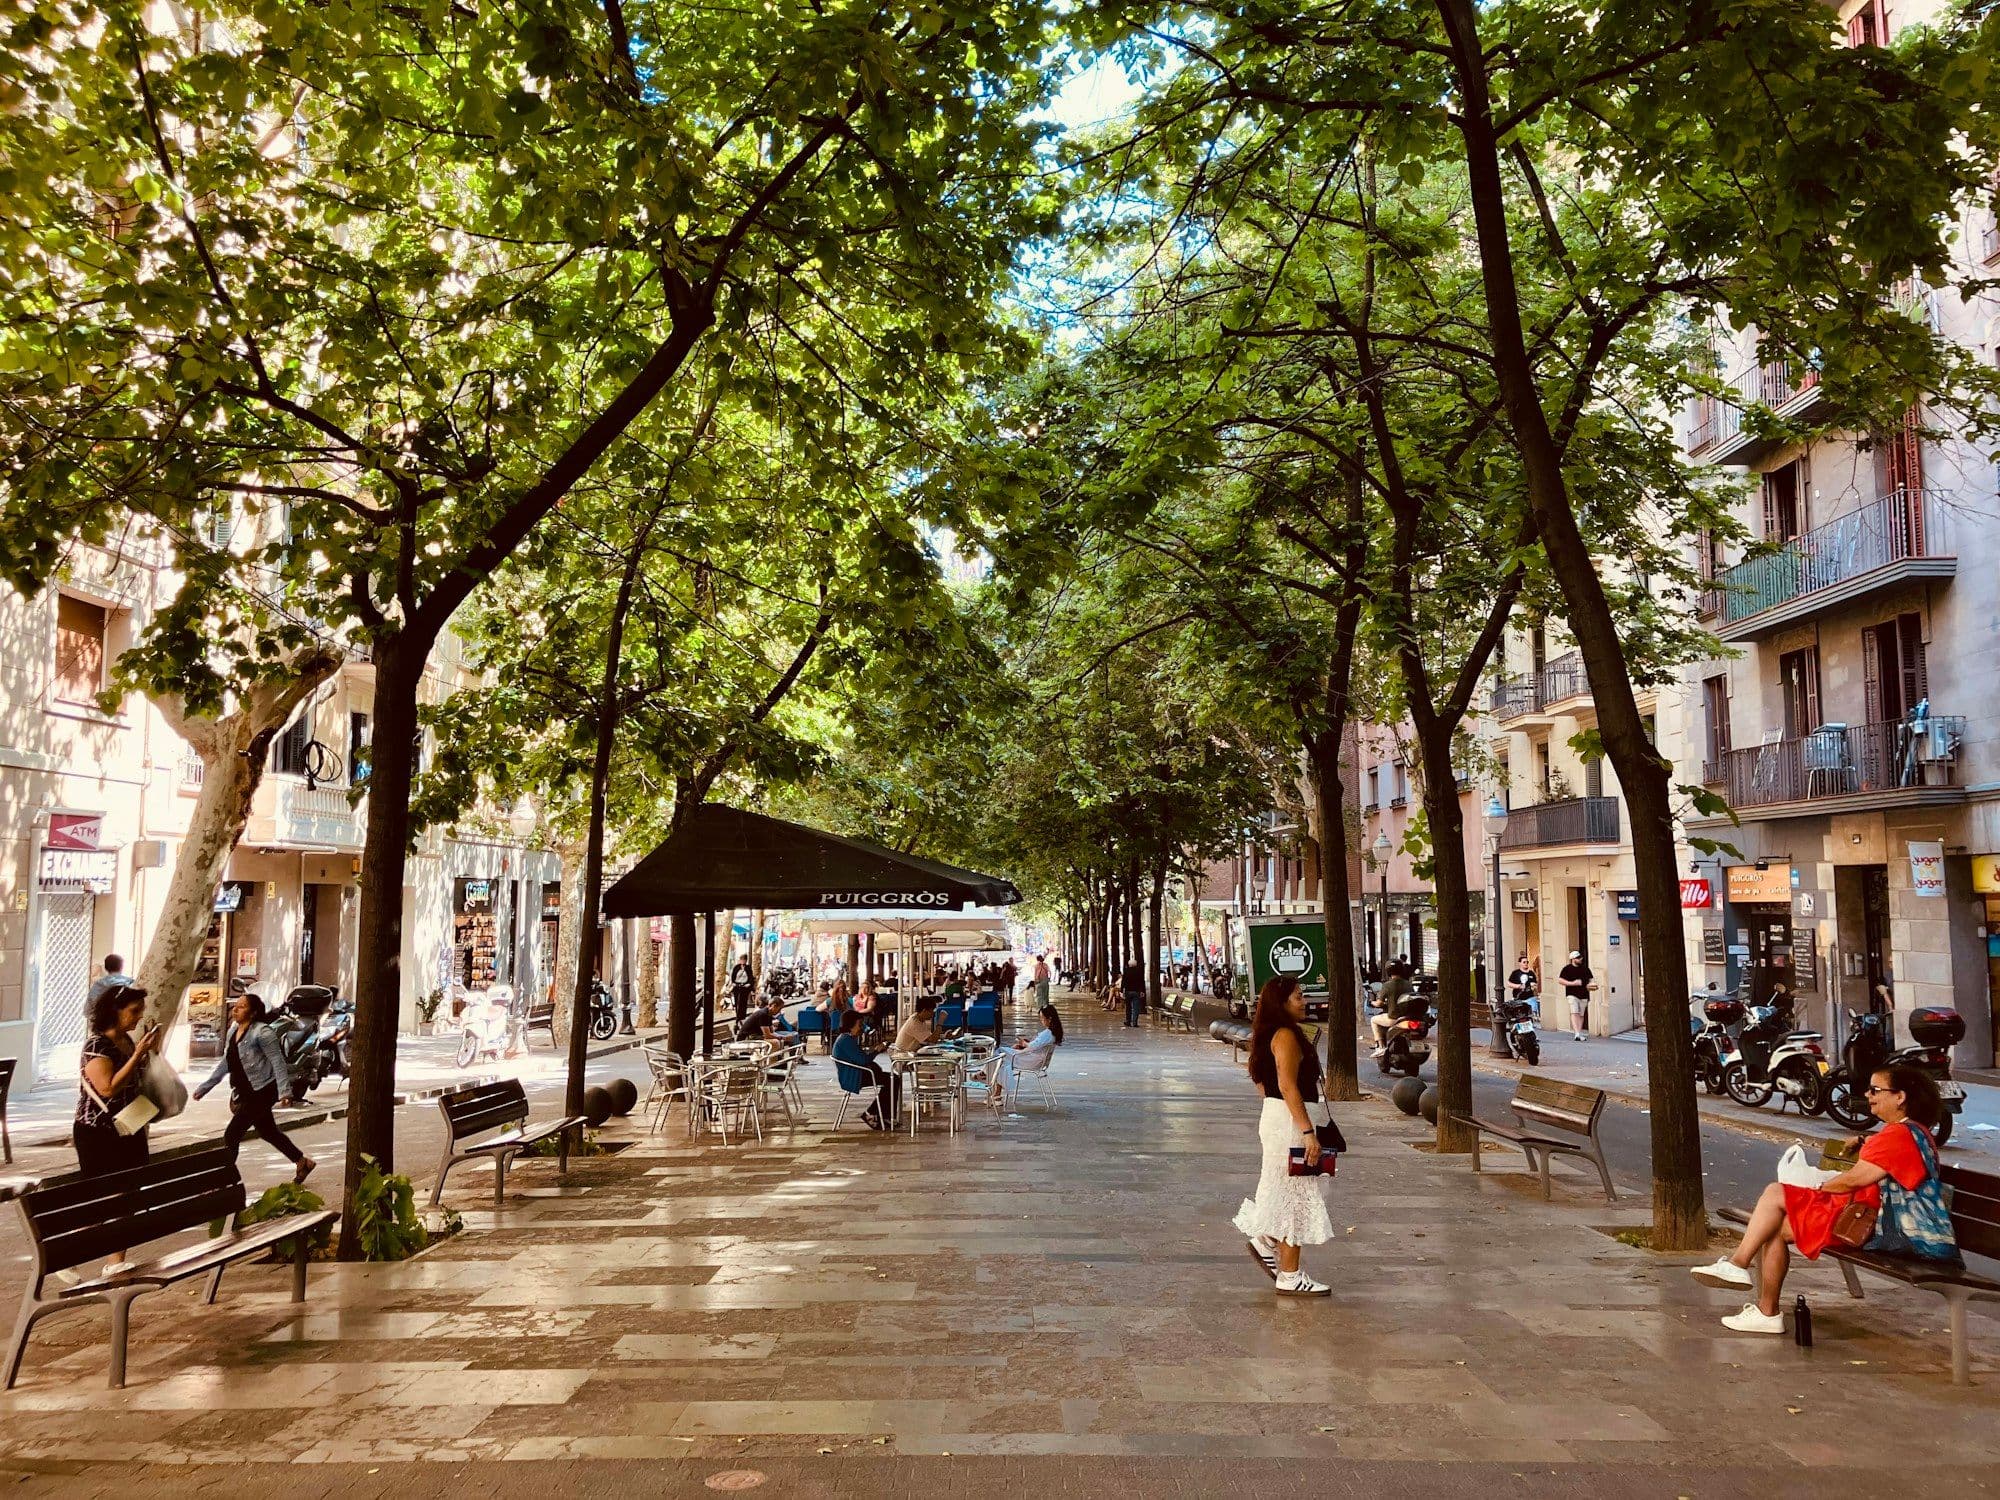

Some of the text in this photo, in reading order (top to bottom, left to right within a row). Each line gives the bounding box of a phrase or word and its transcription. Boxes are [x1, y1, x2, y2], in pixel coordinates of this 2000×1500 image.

[70, 826, 98, 838] ATM
[820, 891, 949, 905] PUIGGRÒS
[1681, 883, 1708, 906] illy
